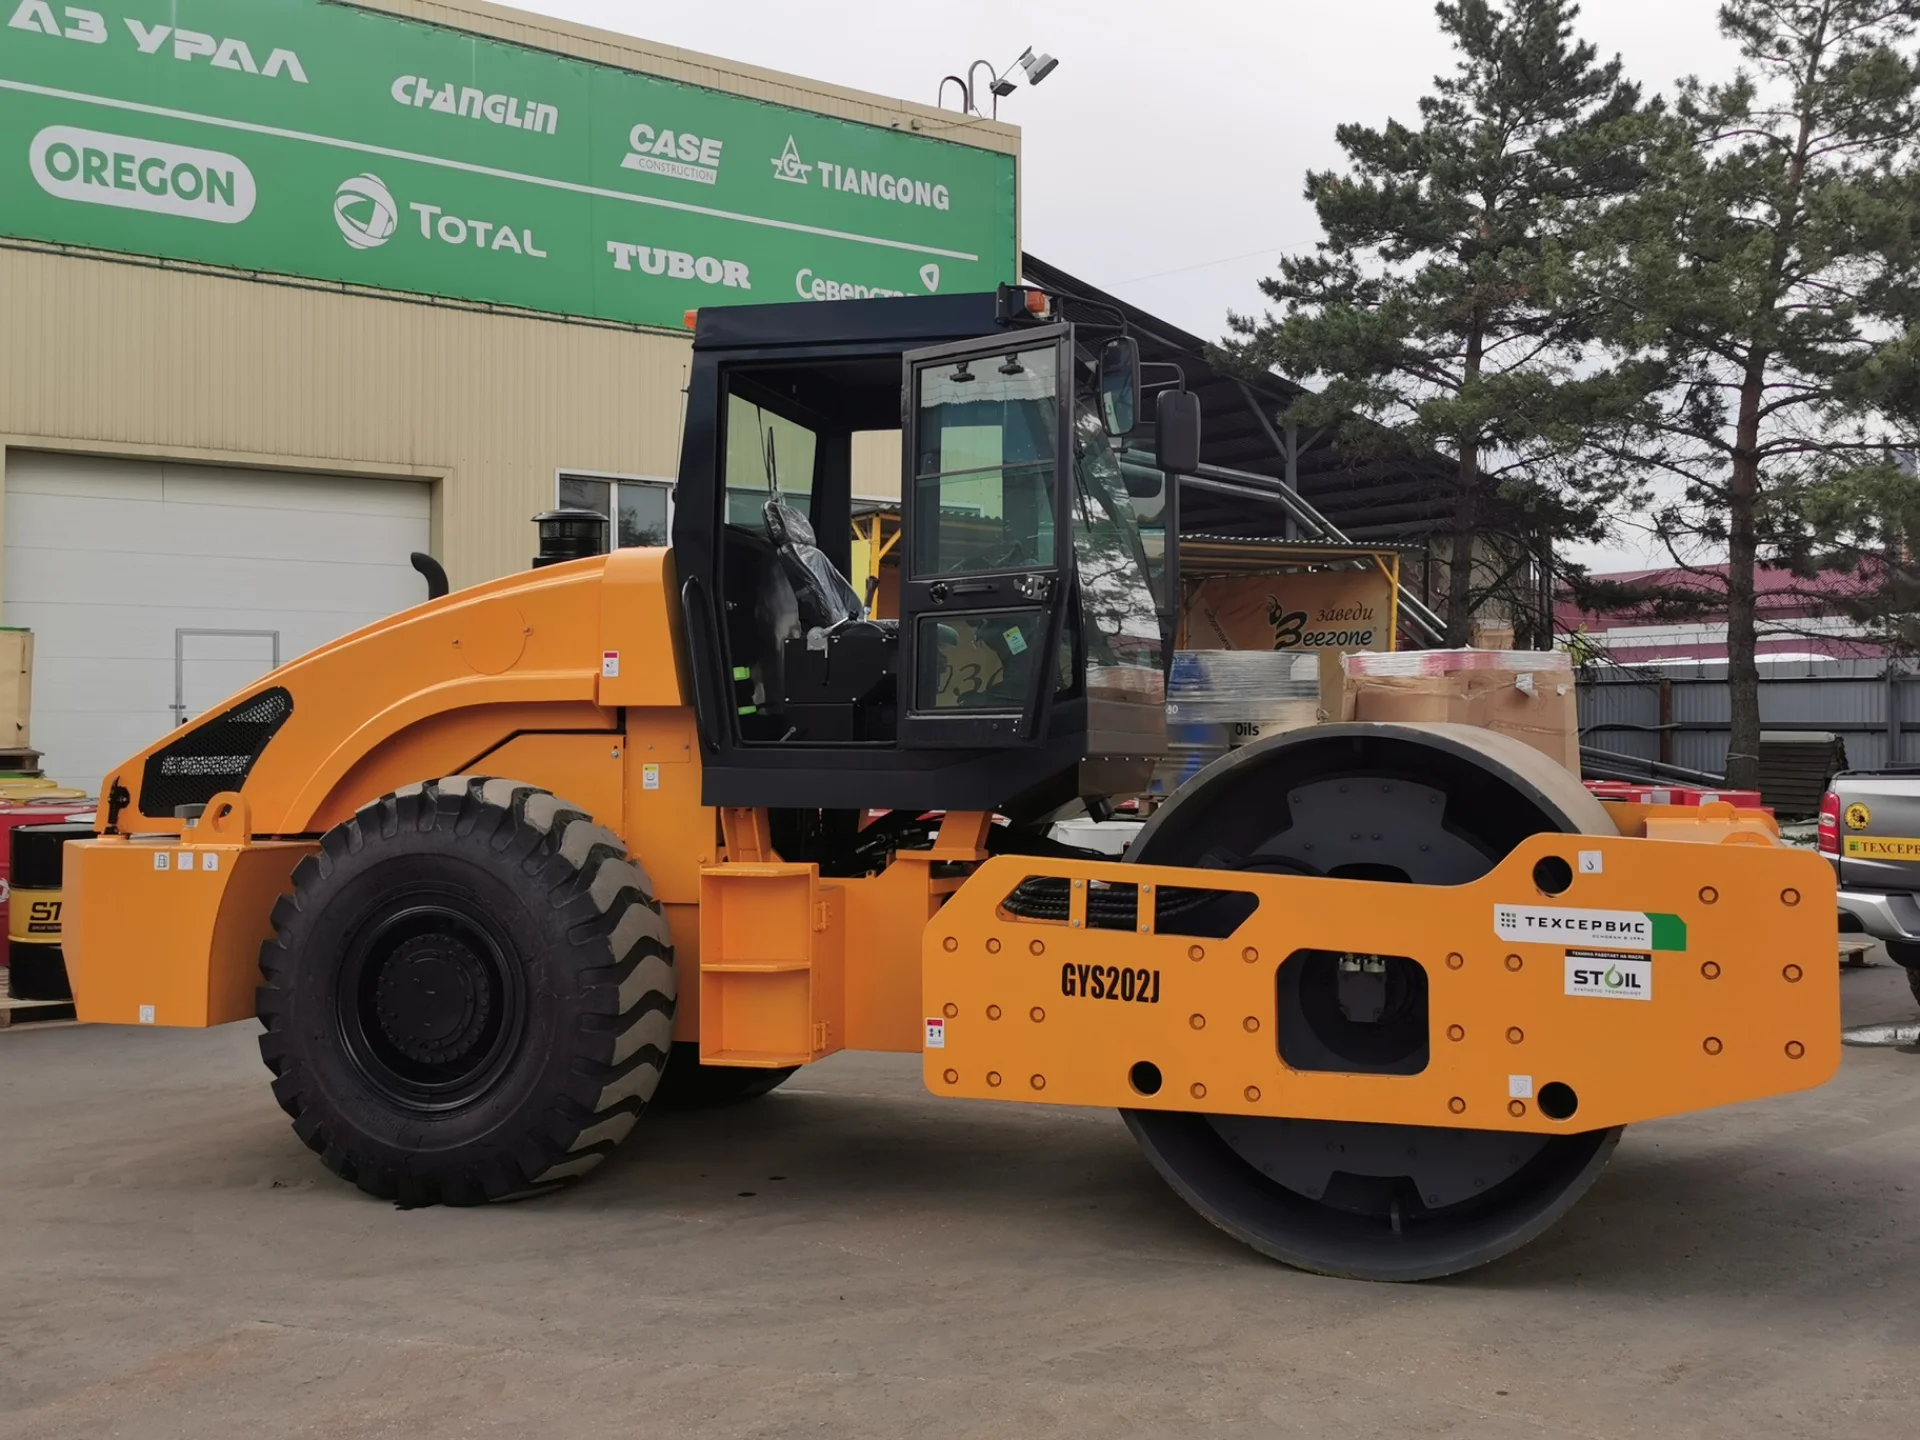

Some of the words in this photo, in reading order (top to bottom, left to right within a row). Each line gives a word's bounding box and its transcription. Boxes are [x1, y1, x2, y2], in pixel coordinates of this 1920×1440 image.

[123, 17, 309, 84] УРАЛ
[629, 123, 723, 167] CASE
[44, 142, 235, 206] OREGON
[638, 158, 714, 181] CONSTRUCTION
[817, 161, 949, 211] TIANGONG
[410, 202, 547, 258] TOTAL
[606, 240, 752, 290] TUBOR
[1316, 600, 1374, 622] заведи
[1525, 916, 1645, 934] ТЕХСЕРВИС
[1061, 962, 1160, 1004] GYS202J
